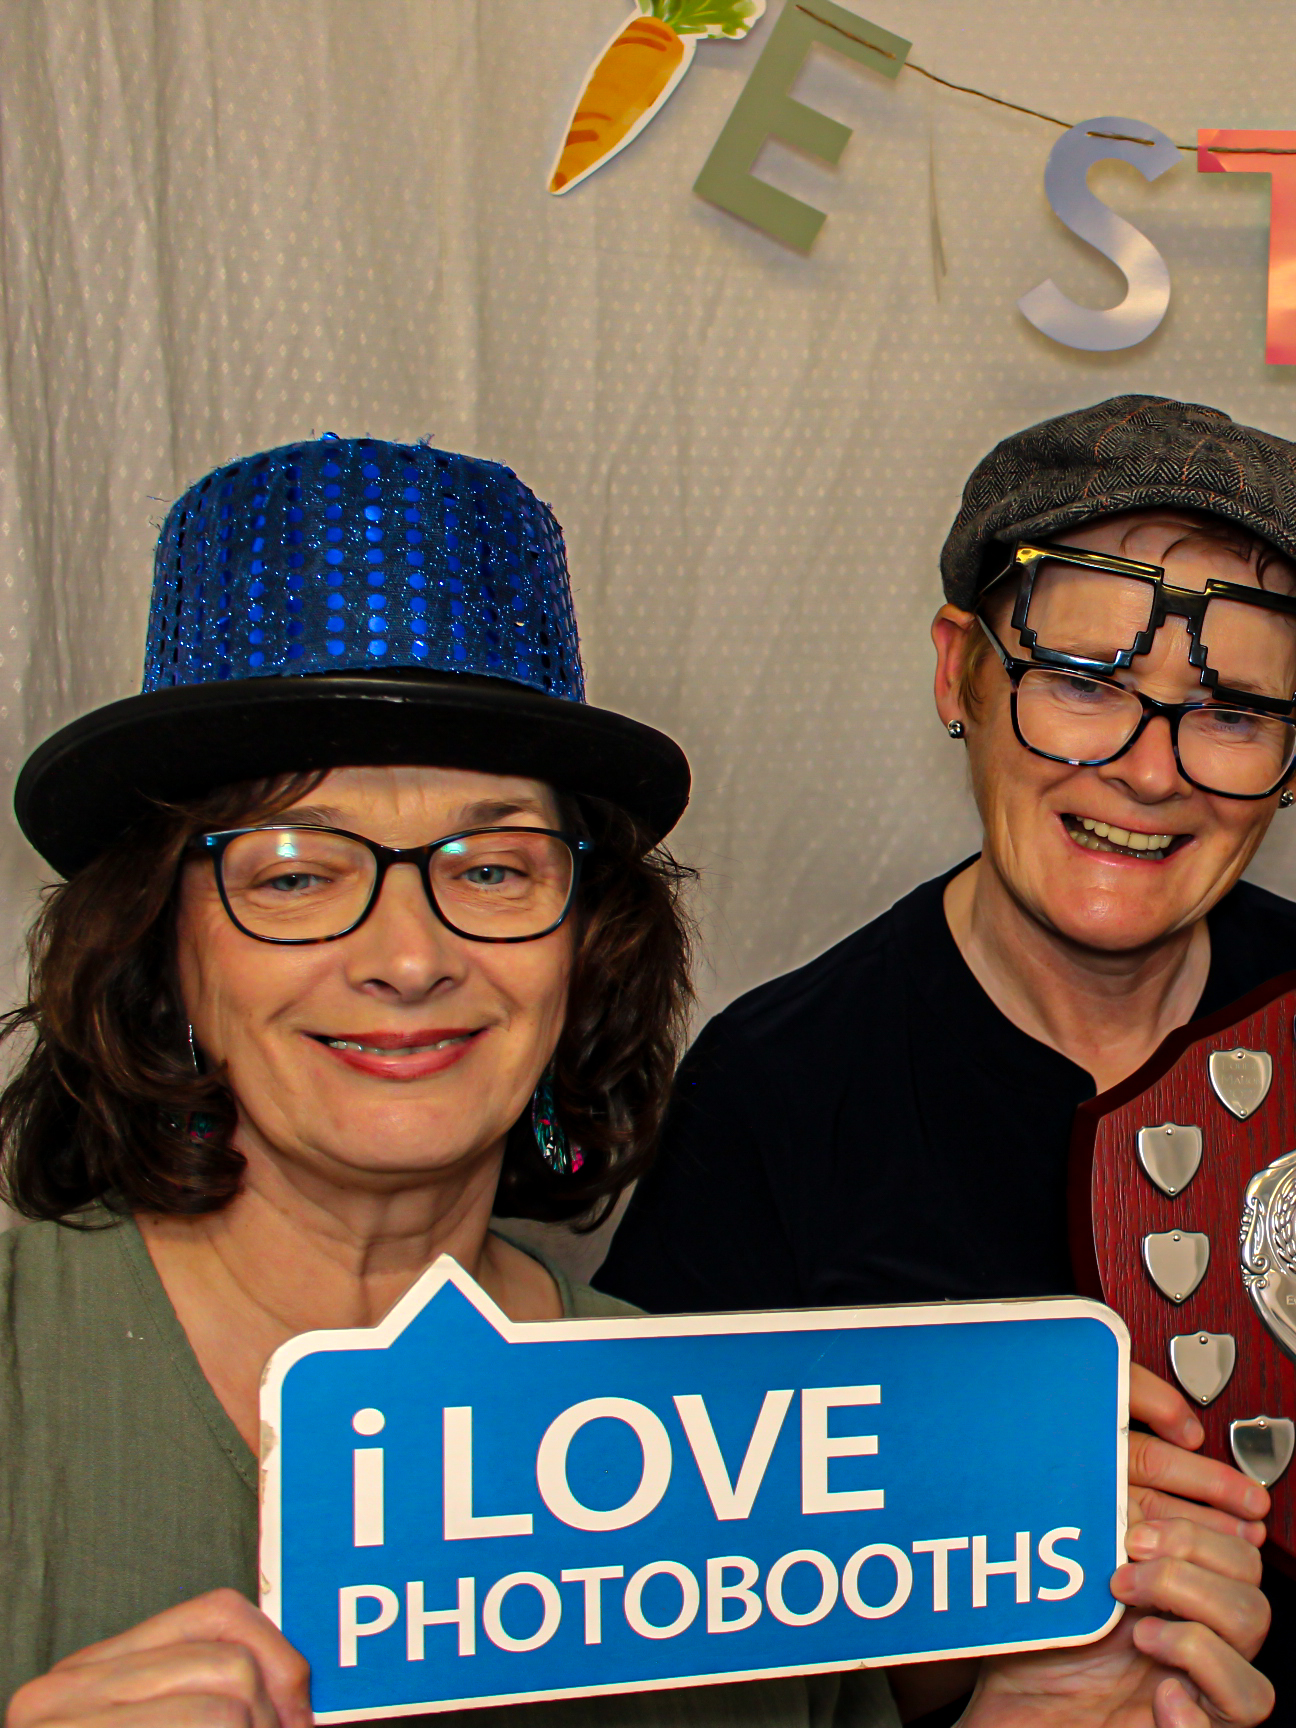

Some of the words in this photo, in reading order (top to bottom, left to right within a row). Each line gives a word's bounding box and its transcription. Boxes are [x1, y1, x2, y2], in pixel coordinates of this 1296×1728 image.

[351, 1407, 386, 1547] i
[442, 1384, 886, 1542] LOVE
[338, 1526, 1085, 1668] PHOTOBOOTHS
